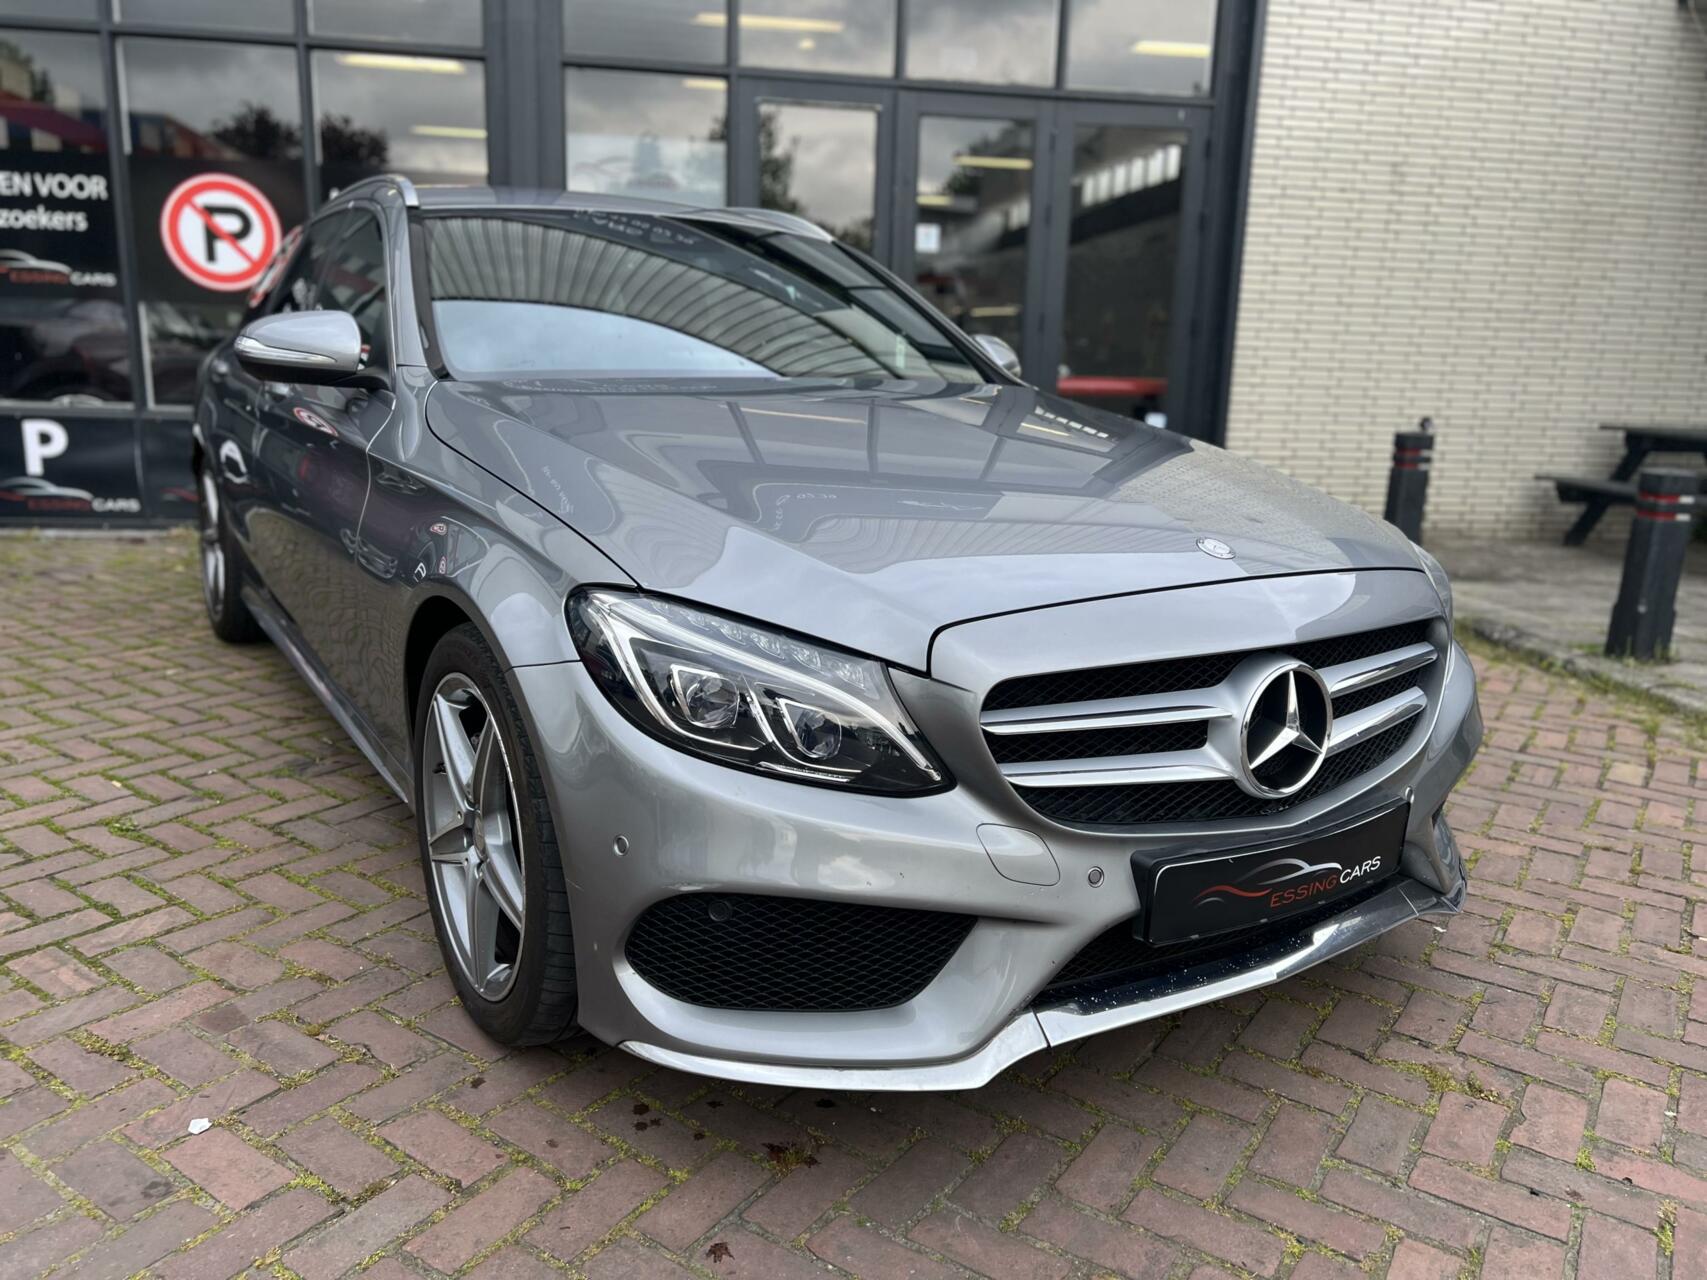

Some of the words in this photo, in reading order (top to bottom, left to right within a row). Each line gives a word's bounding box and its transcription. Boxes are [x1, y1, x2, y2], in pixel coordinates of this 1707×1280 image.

[33, 172, 108, 200] VOOR
[203, 205, 252, 263] P
[21, 419, 68, 476] P
